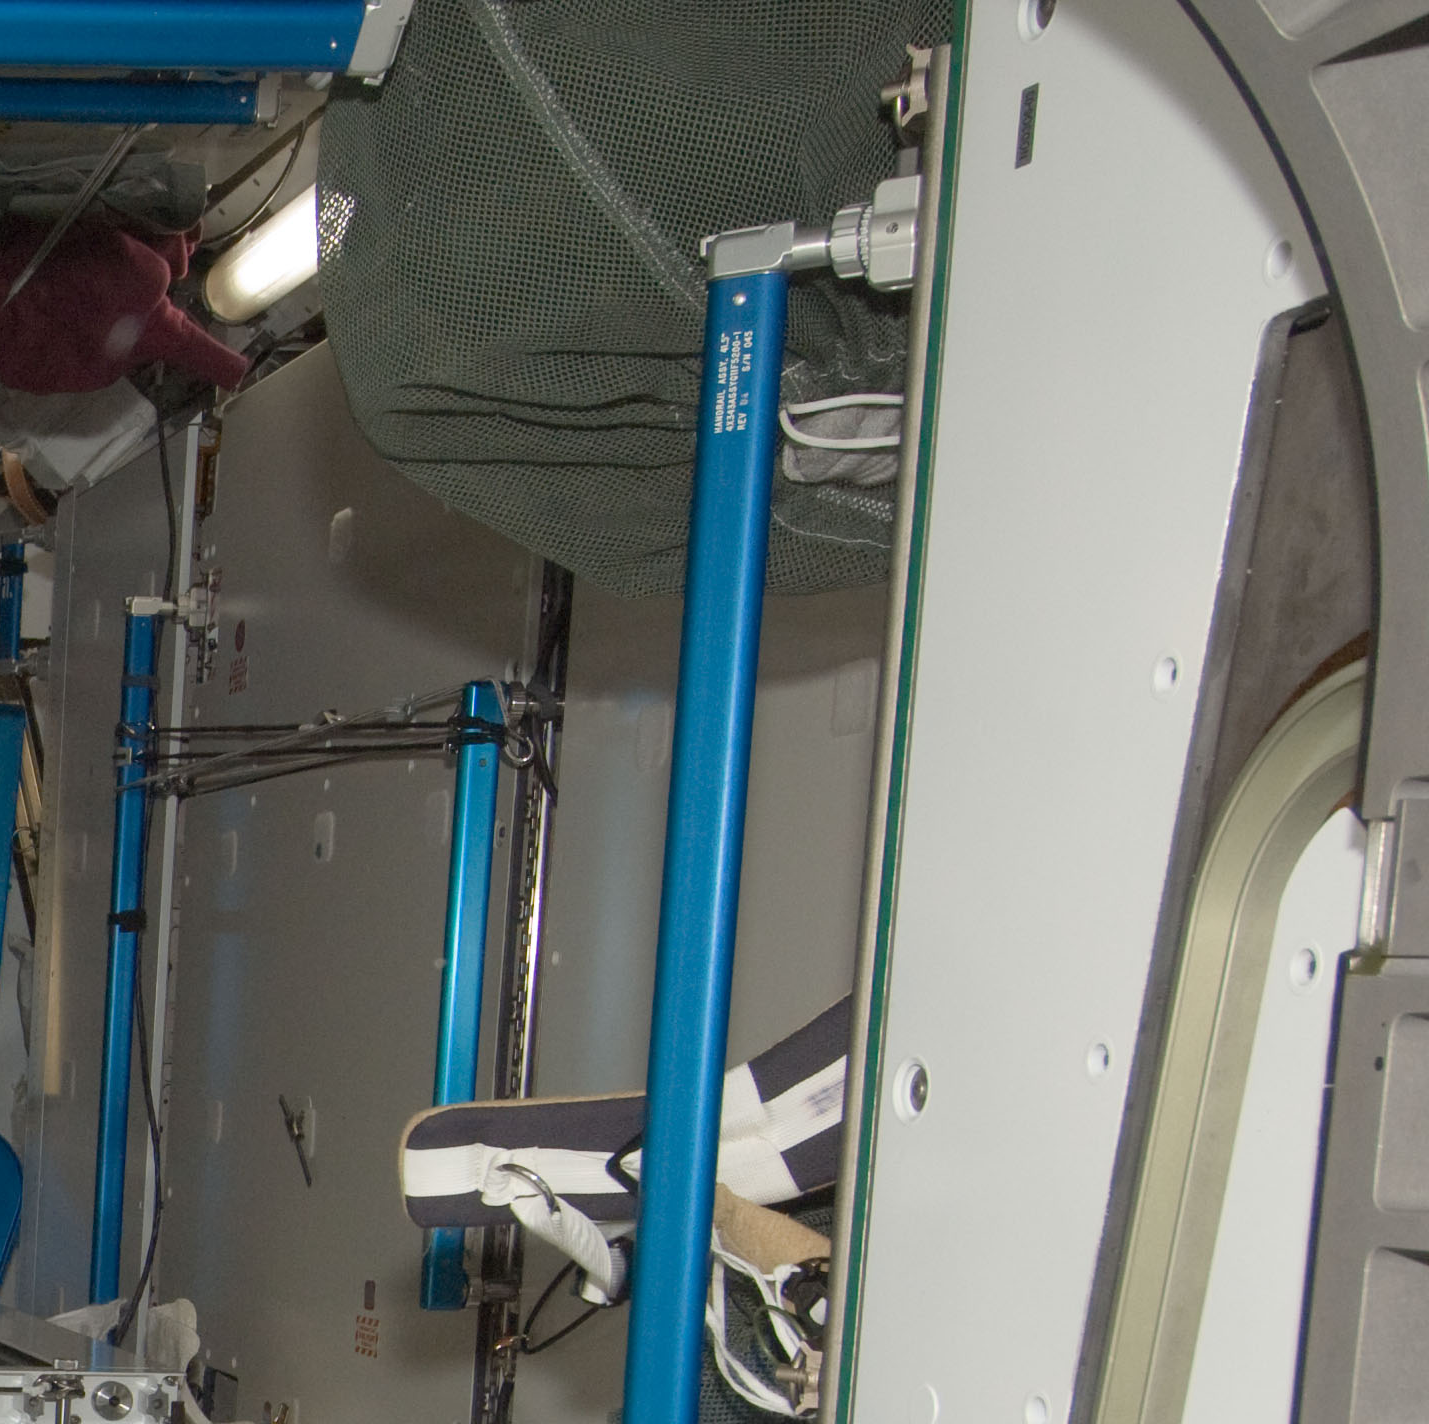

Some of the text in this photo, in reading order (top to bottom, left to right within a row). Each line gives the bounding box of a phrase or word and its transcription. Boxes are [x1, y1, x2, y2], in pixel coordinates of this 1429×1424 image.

[741, 353, 751, 373] S/N
[714, 389, 726, 434] HANDRAIL
[737, 412, 747, 431] REV
